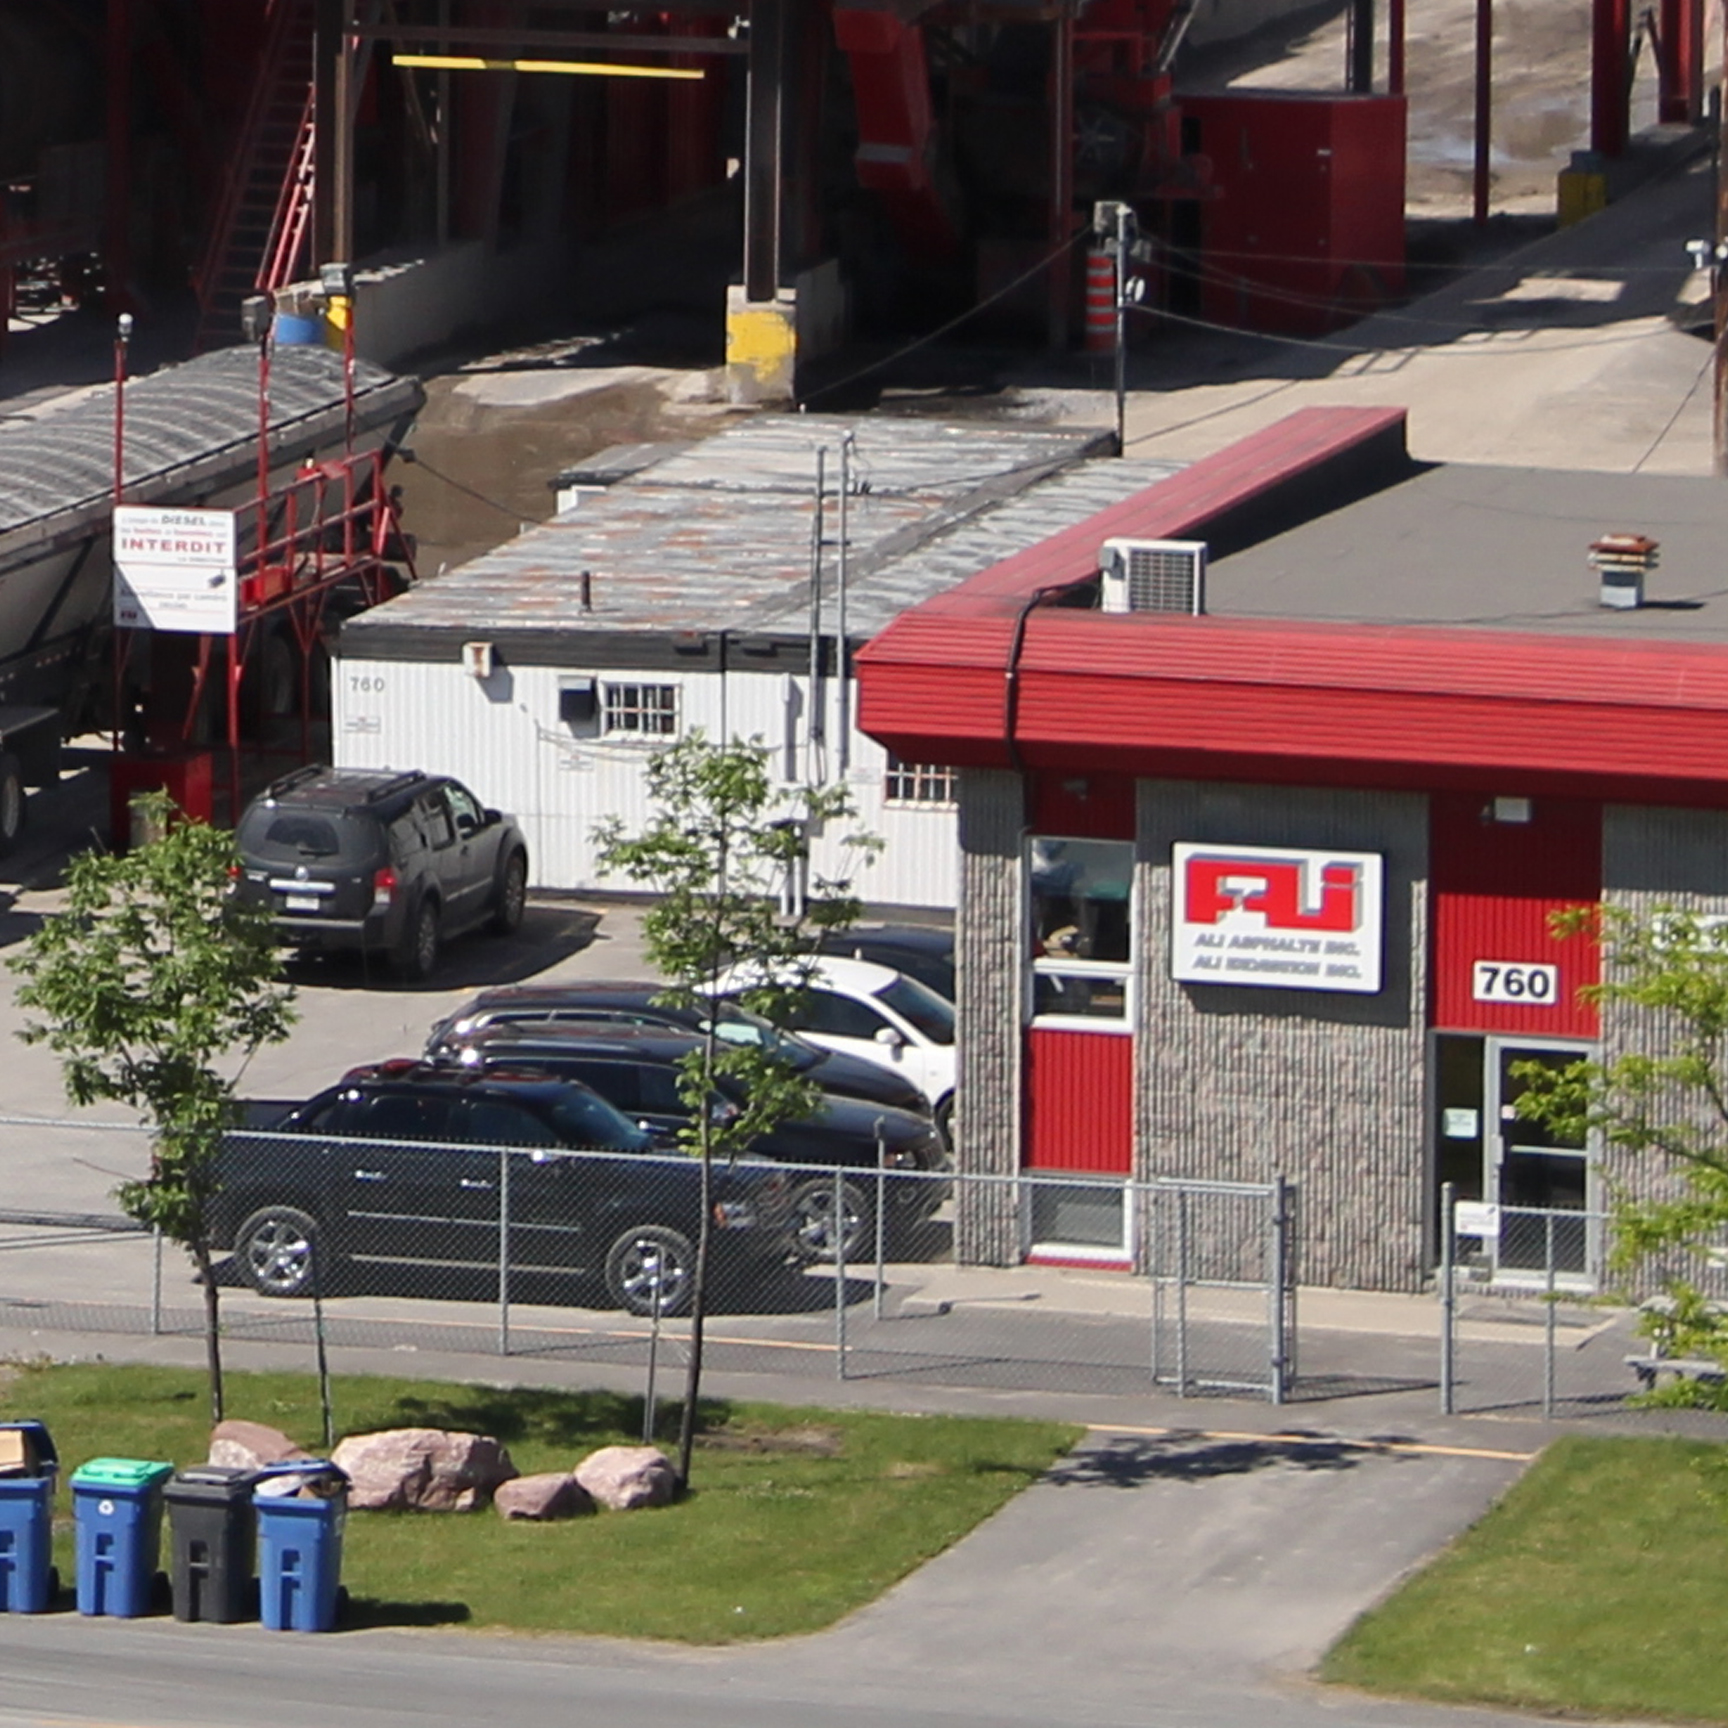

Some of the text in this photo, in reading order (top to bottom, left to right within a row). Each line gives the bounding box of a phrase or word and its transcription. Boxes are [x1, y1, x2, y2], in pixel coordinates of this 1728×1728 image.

[121, 537, 226, 554] INTERDIT
[350, 676, 385, 692] 760
[1479, 966, 1550, 999] 760
